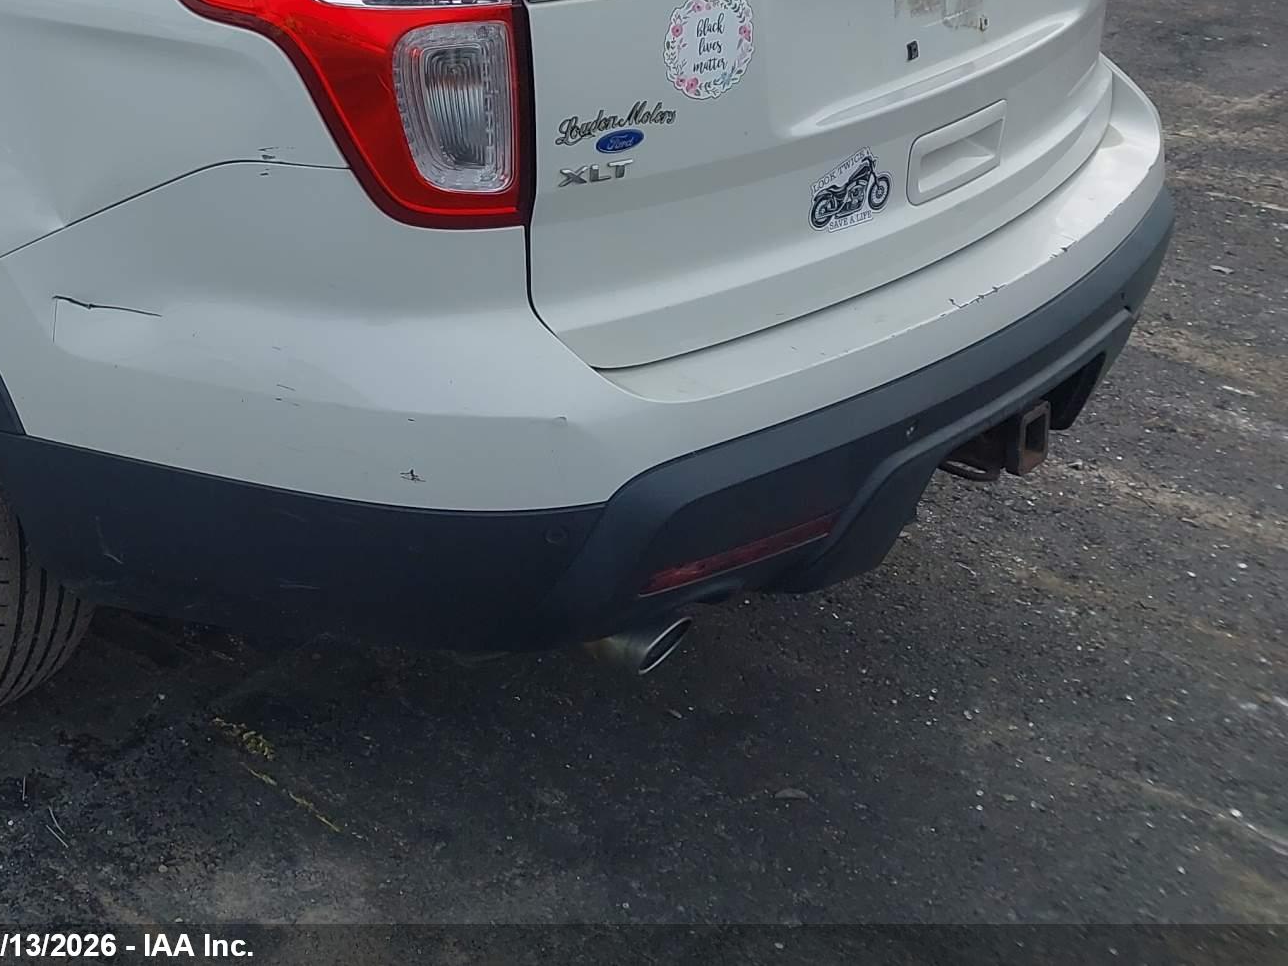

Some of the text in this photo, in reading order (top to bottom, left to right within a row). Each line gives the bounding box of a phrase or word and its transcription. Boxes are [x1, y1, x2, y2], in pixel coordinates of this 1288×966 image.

[699, 37, 722, 56] lives
[693, 57, 727, 74] matter
[558, 158, 633, 188] XLT
[813, 173, 837, 193] LOOK
[829, 217, 849, 230] SAVE
[856, 209, 872, 222] LIFE
